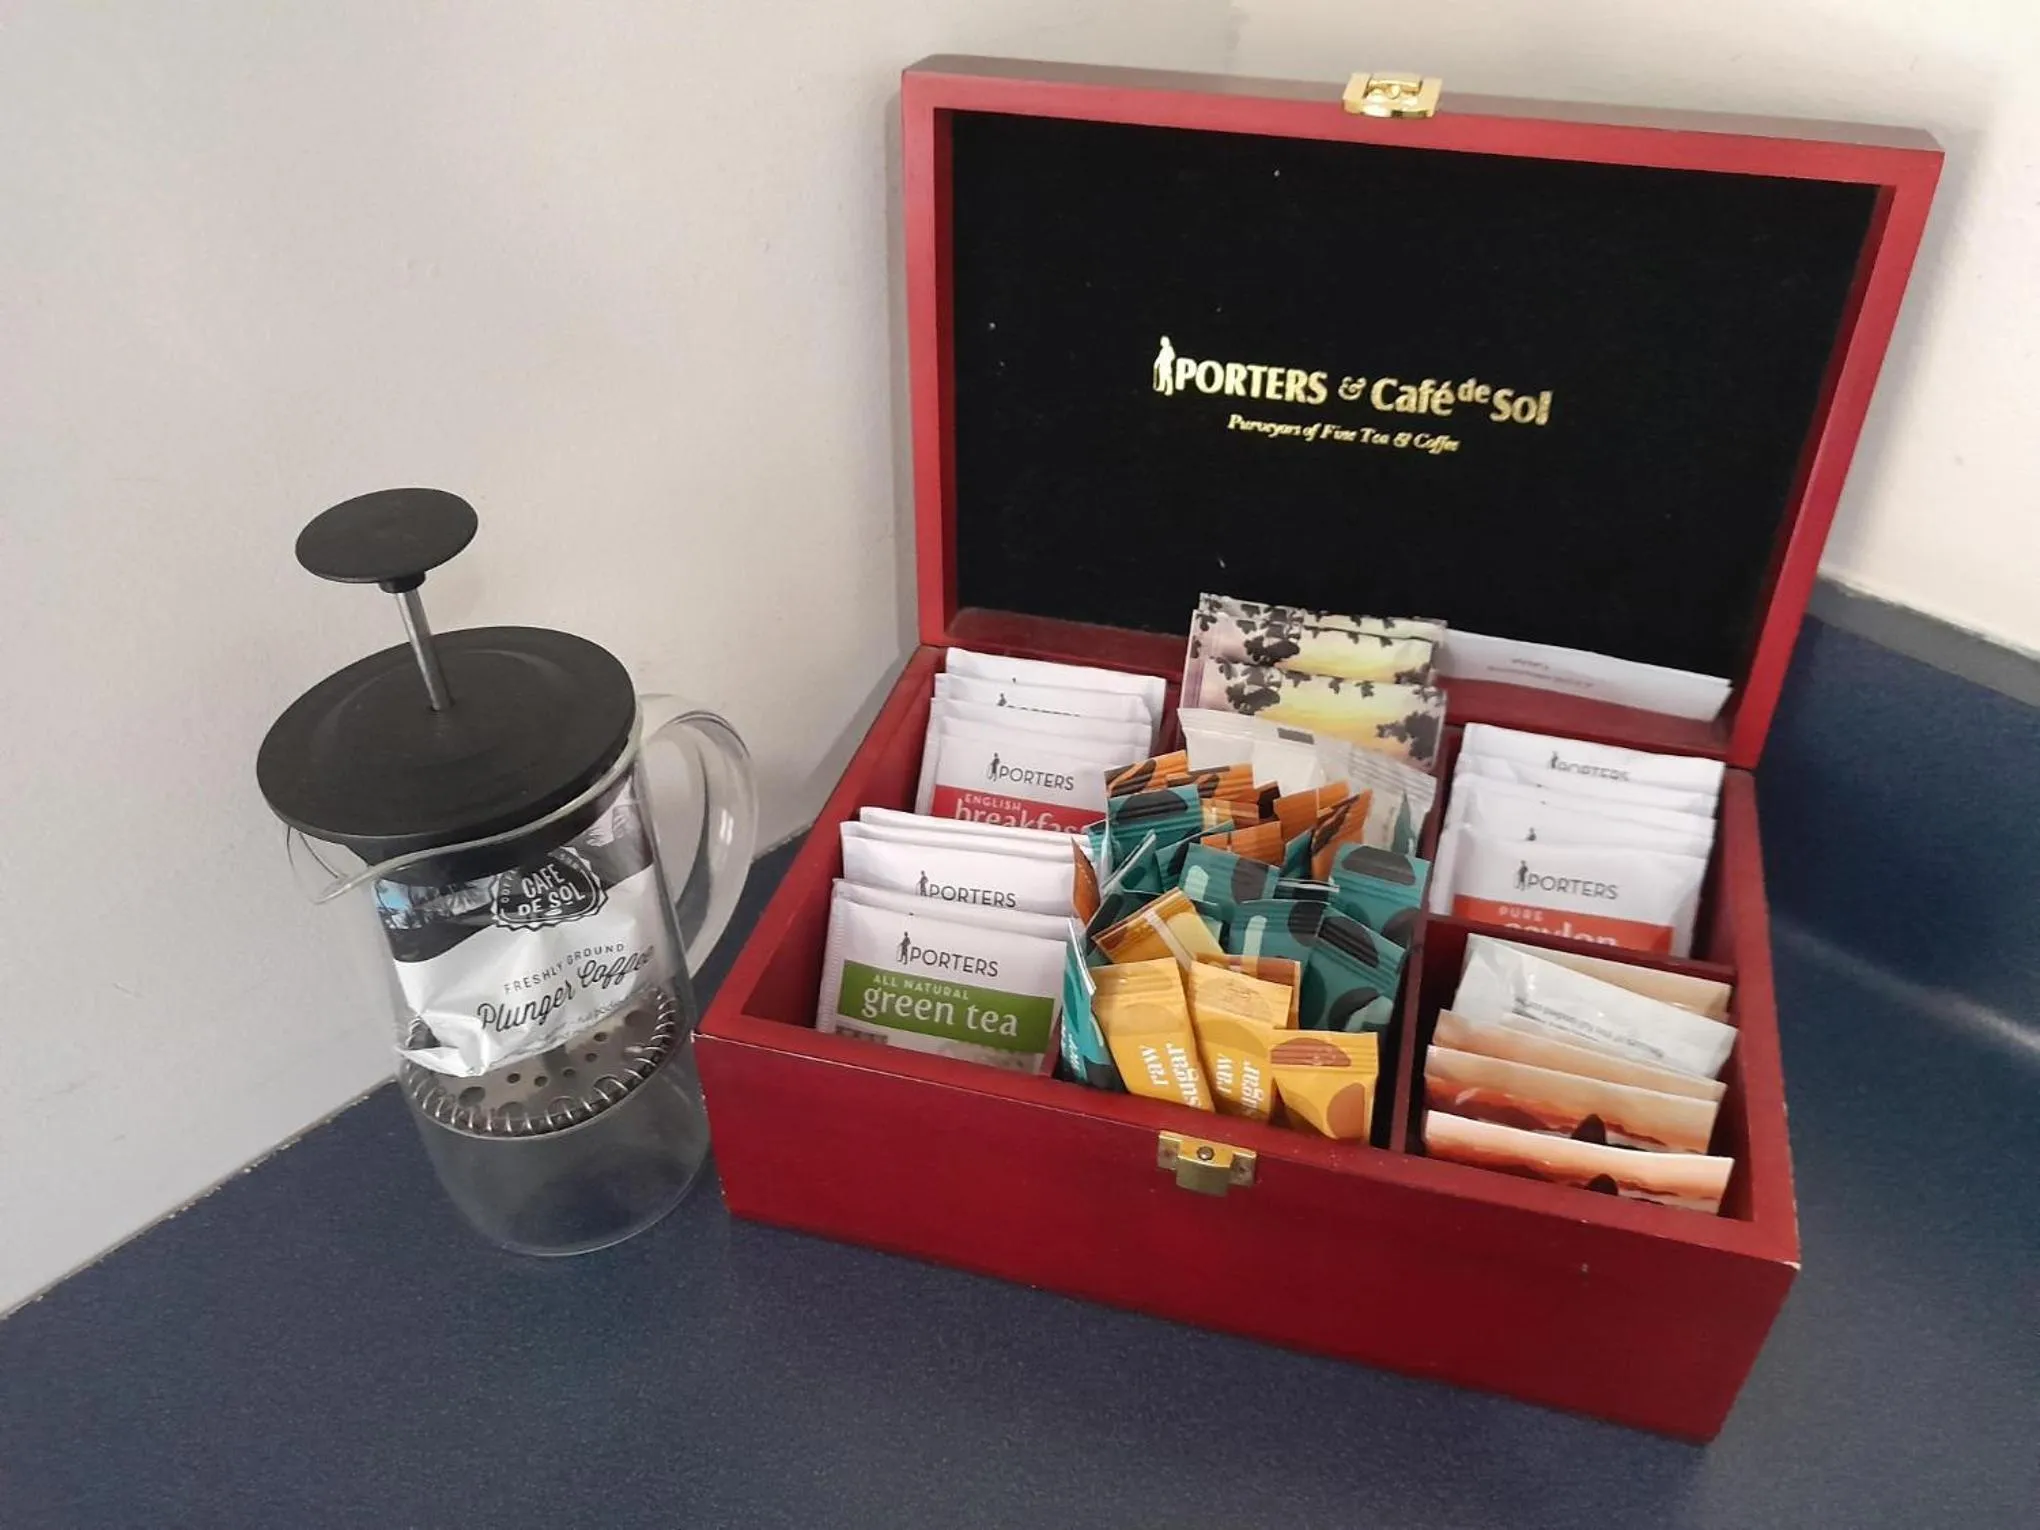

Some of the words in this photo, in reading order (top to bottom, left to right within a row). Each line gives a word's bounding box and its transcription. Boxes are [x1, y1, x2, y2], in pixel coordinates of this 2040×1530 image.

[1174, 357, 1328, 405] PORTERS
[1338, 376, 1365, 400] &
[1371, 377, 1454, 417] Café
[1458, 378, 1490, 404] de
[1490, 388, 1553, 426] Sol
[1303, 423, 1322, 442] of
[1320, 424, 1356, 442] Fine
[1360, 427, 1389, 444] Tea
[1393, 432, 1412, 448] &
[1413, 432, 1460, 454] Coffee
[999, 765, 1074, 791] PORTERS
[964, 793, 1022, 811] ENGLISH
[521, 863, 565, 898] CAFE
[929, 884, 1017, 908] PORTERS
[1528, 873, 1619, 900] PORTERS
[518, 898, 544, 916] DE
[548, 882, 586, 909] SOL
[1499, 905, 1544, 922] PURE
[504, 961, 564, 995] FRESHLY
[566, 943, 625, 966] GROUND
[910, 946, 999, 977] PORTERS
[477, 979, 575, 1033] Plunger
[577, 945, 654, 990] Coffee
[873, 974, 898, 988] ALL
[904, 979, 969, 1000] NATURAL
[862, 987, 955, 1026] green
[967, 1004, 1018, 1037] tea
[1138, 1044, 1169, 1086] raw
[1166, 1042, 1202, 1109] sugar
[1215, 1053, 1233, 1094] raw
